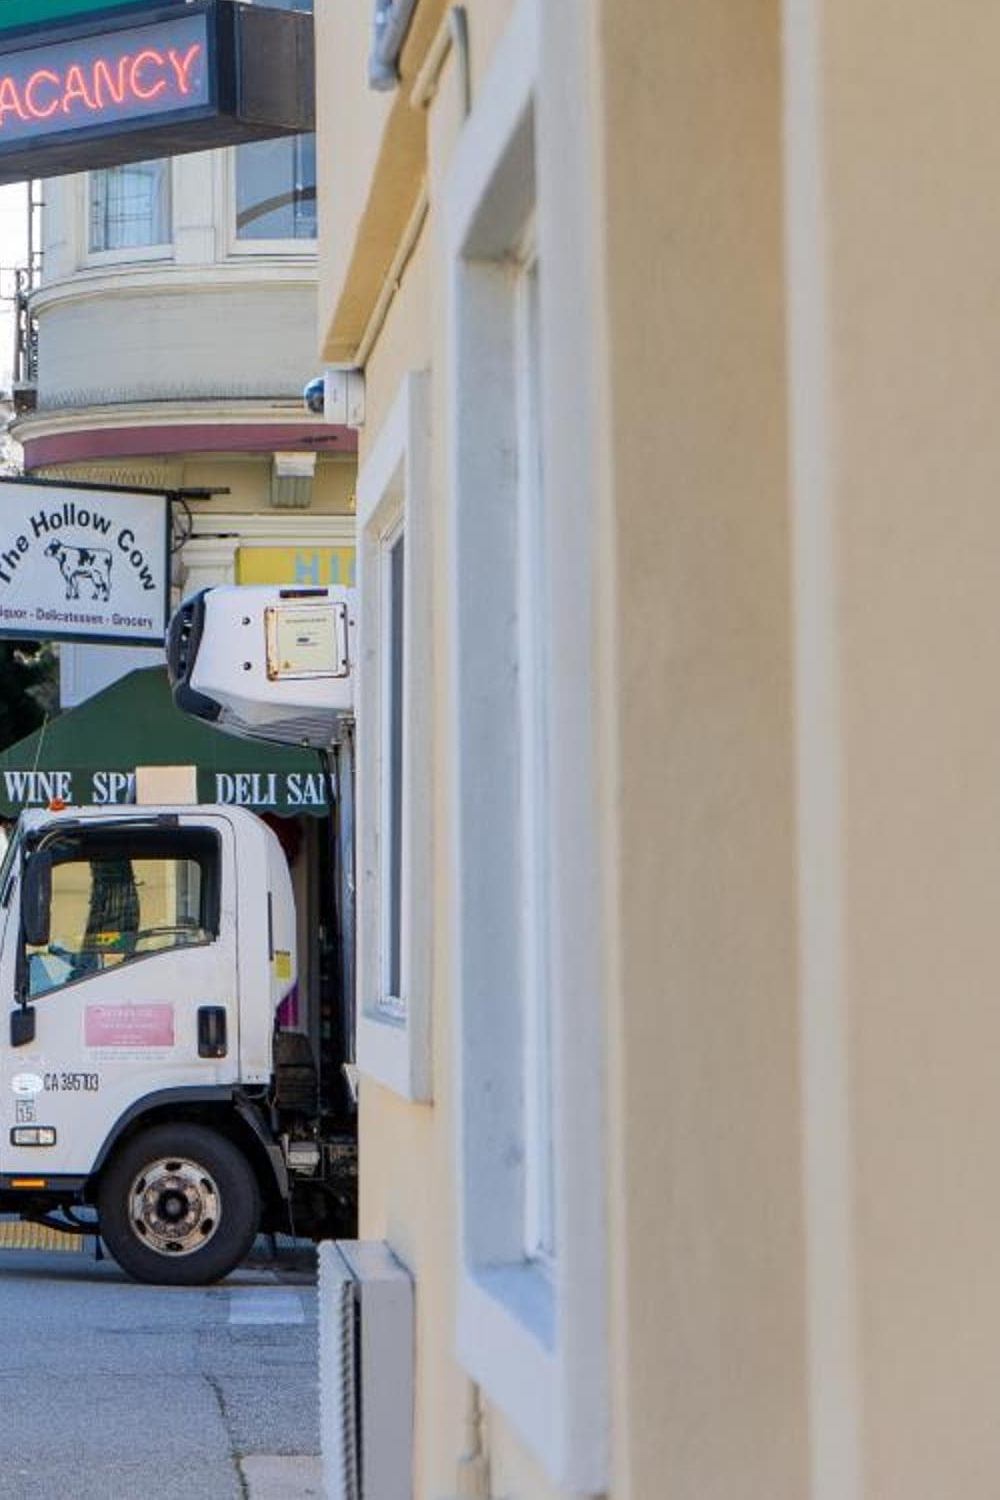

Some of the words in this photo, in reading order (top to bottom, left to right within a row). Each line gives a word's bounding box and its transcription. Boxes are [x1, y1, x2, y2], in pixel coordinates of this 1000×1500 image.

[29, 502, 112, 539] Hollow
[117, 528, 156, 591] Cow
[35, 607, 104, 625] Delicatessen
[111, 612, 153, 629] Grocery
[3, 771, 73, 803] WINE
[216, 772, 277, 805] DELI
[43, 1072, 60, 1092] CA
